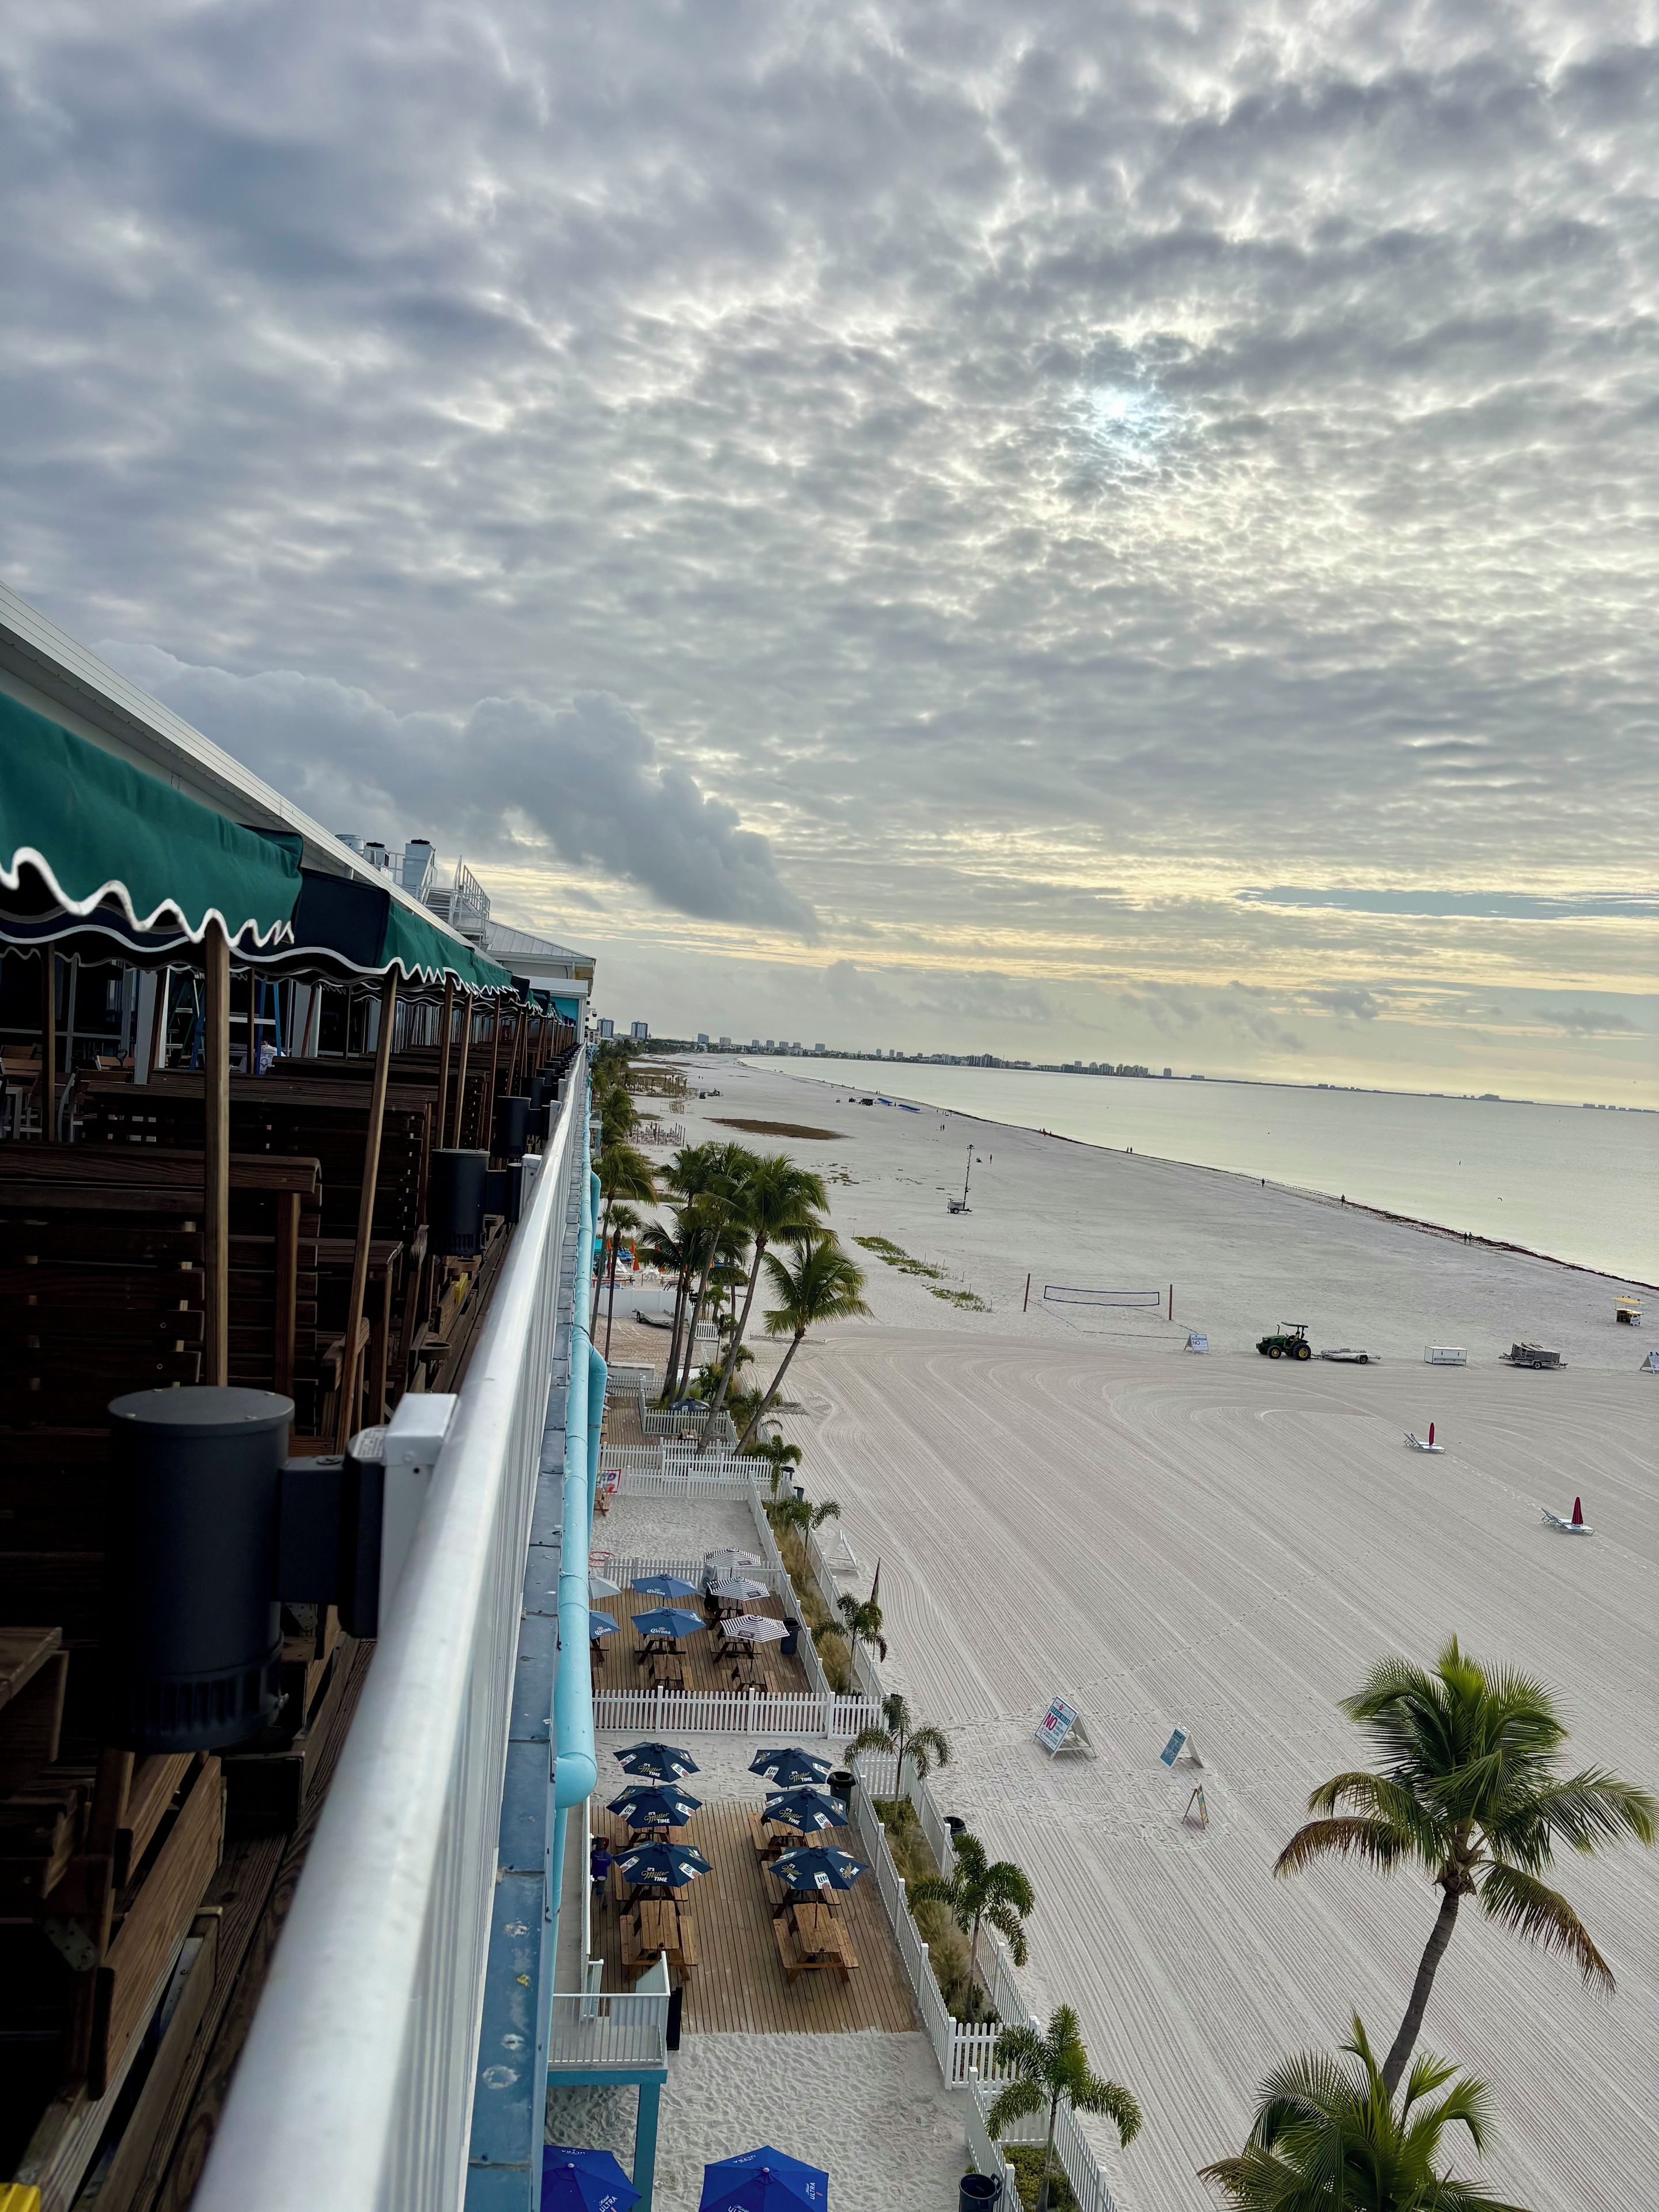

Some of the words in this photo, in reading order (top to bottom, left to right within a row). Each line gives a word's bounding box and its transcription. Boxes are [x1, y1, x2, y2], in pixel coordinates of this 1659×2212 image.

[594, 1627, 612, 1635] Corona
[650, 1627, 671, 1635] Corona
[1043, 1713, 1058, 1731] NO
[644, 1813, 670, 1824] Miller
[788, 1817, 801, 1825] TIME
[641, 1870, 669, 1880] Miller
[599, 2196, 618, 2212] ULTRA
